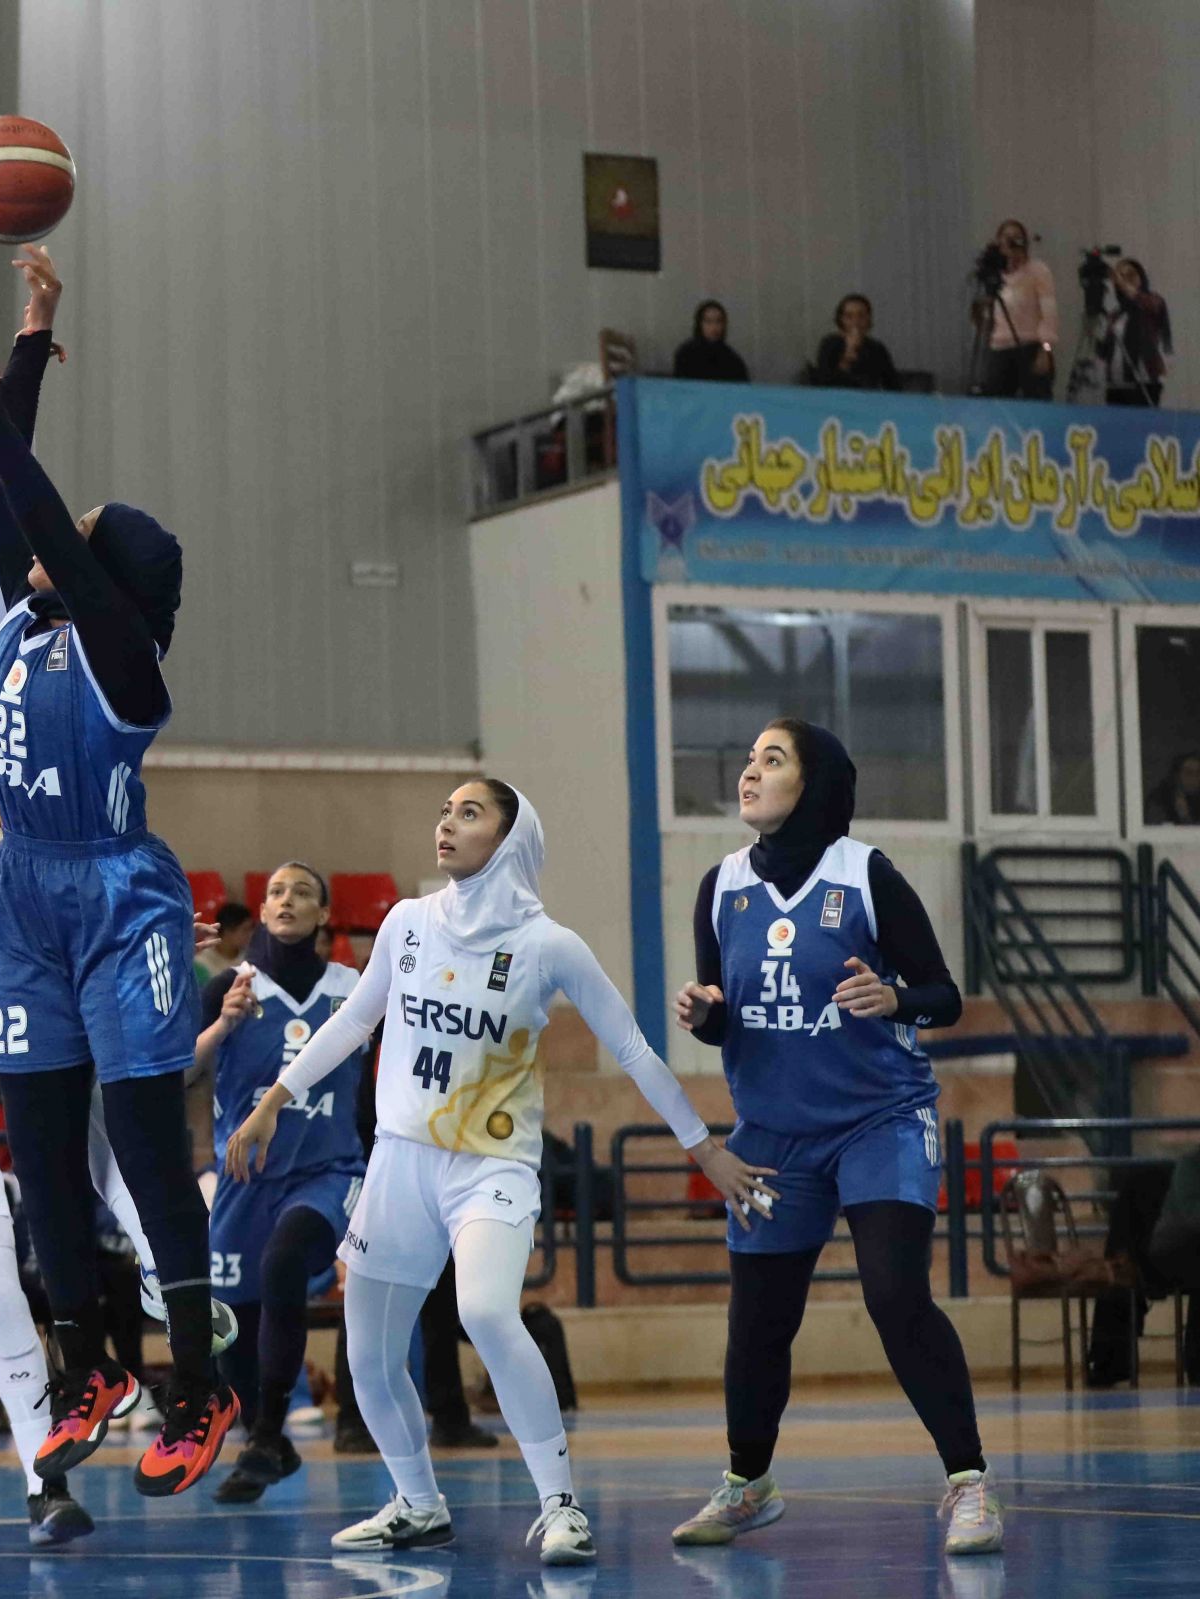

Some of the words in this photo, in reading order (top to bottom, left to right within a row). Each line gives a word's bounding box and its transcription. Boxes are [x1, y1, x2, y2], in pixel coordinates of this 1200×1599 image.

[1092, 434, 1200, 536] سلامی،
[760, 960, 801, 1003] 34
[741, 1001, 843, 1037] S.B.A
[412, 1046, 453, 1094] 44
[210, 1250, 242, 1287] 23
